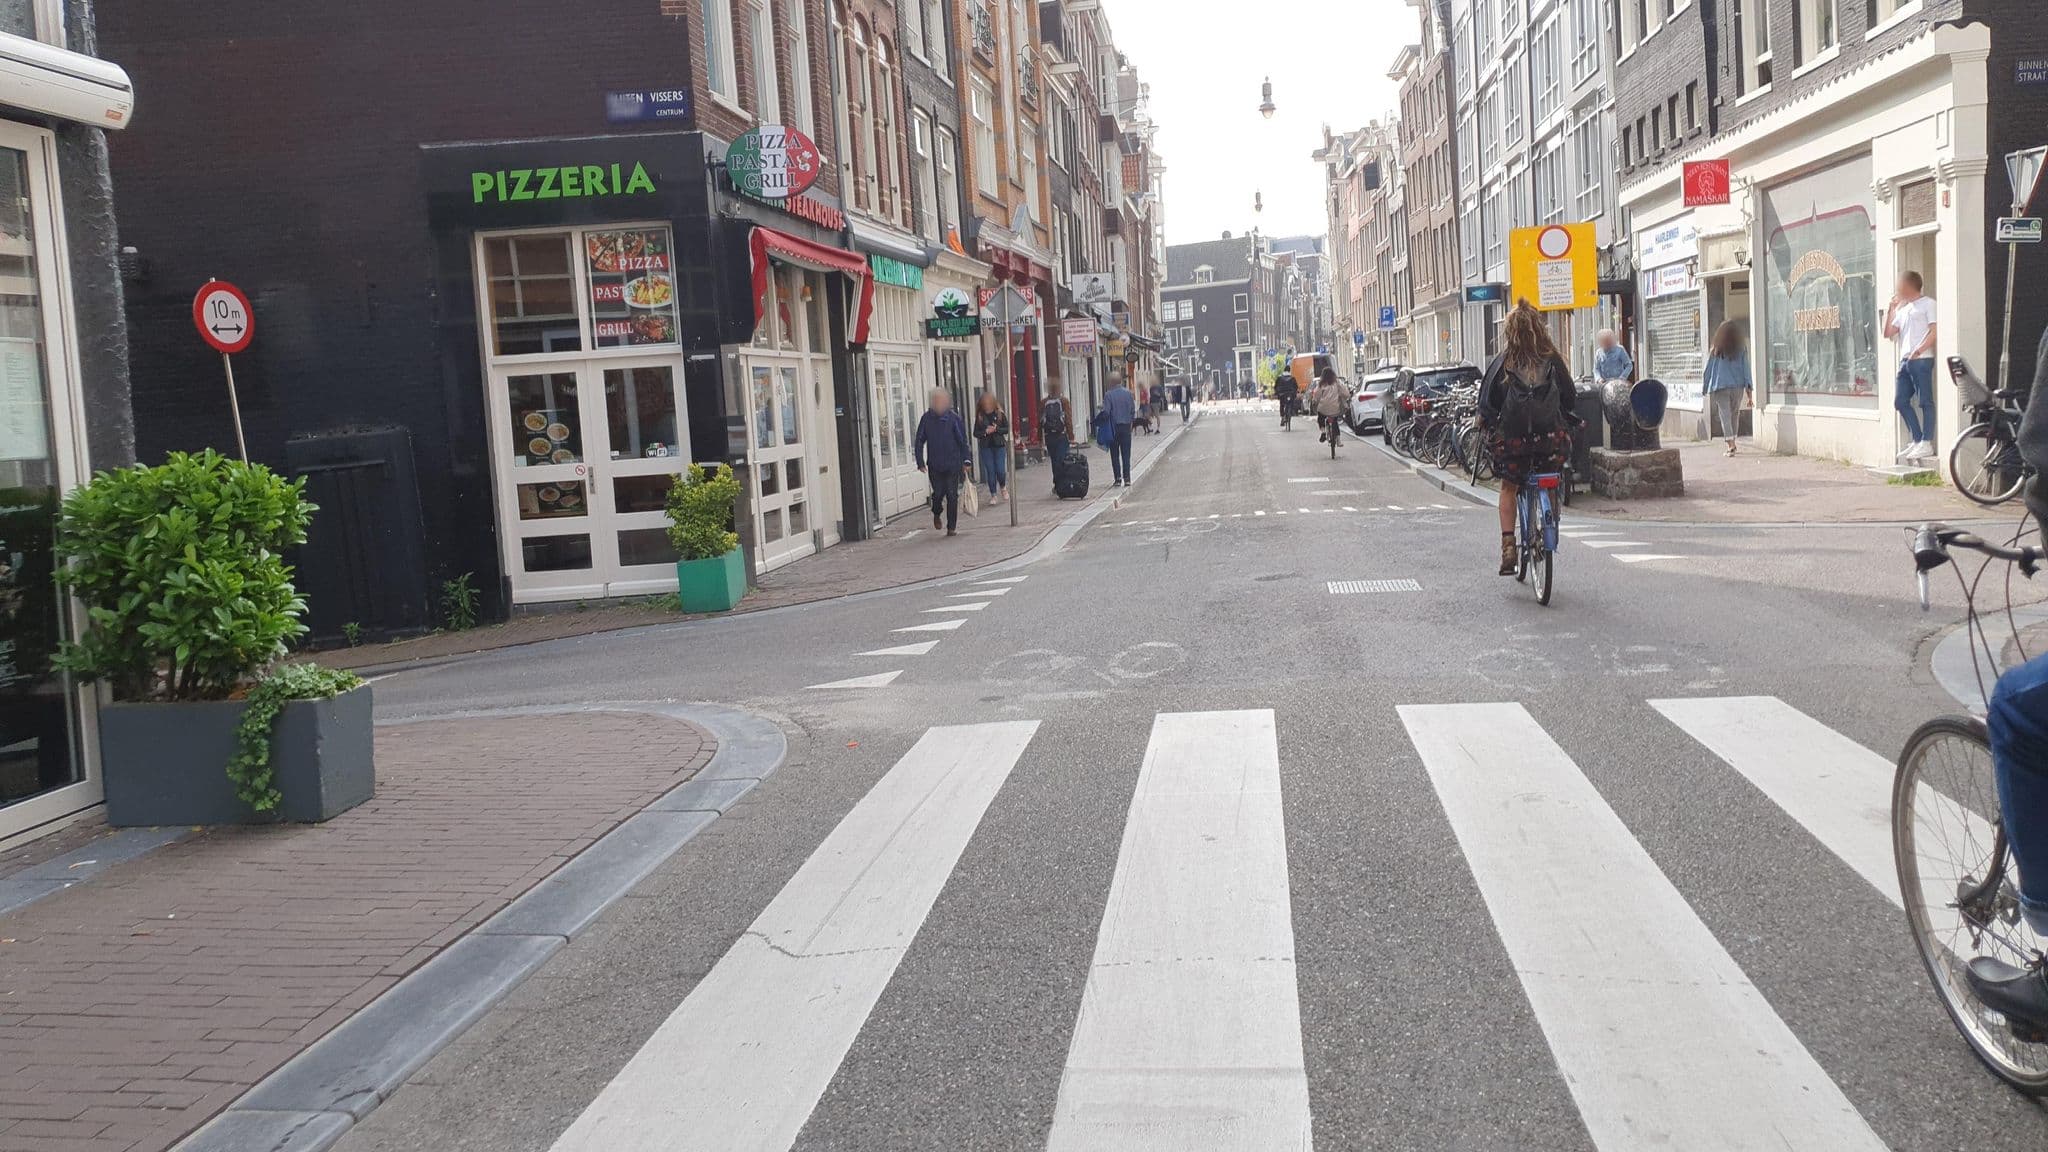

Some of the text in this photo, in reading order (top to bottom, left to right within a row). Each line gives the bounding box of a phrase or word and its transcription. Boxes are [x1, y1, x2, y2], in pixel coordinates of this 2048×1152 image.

[2018, 71, 2046, 82] STRAAT
[650, 90, 684, 103] VISSERS
[656, 108, 684, 117] CENTRUM
[745, 133, 802, 151] PIZZA
[730, 153, 797, 171] PASTA
[472, 160, 656, 203] PIZZERIA
[744, 171, 800, 189] GRILL
[785, 193, 846, 232] STEAKHOUSE
[619, 256, 664, 270] PIZZA
[596, 285, 636, 299] PASTA
[1383, 308, 1390, 319] P
[599, 322, 634, 336] GRILL
[1068, 343, 1093, 353] ATM
